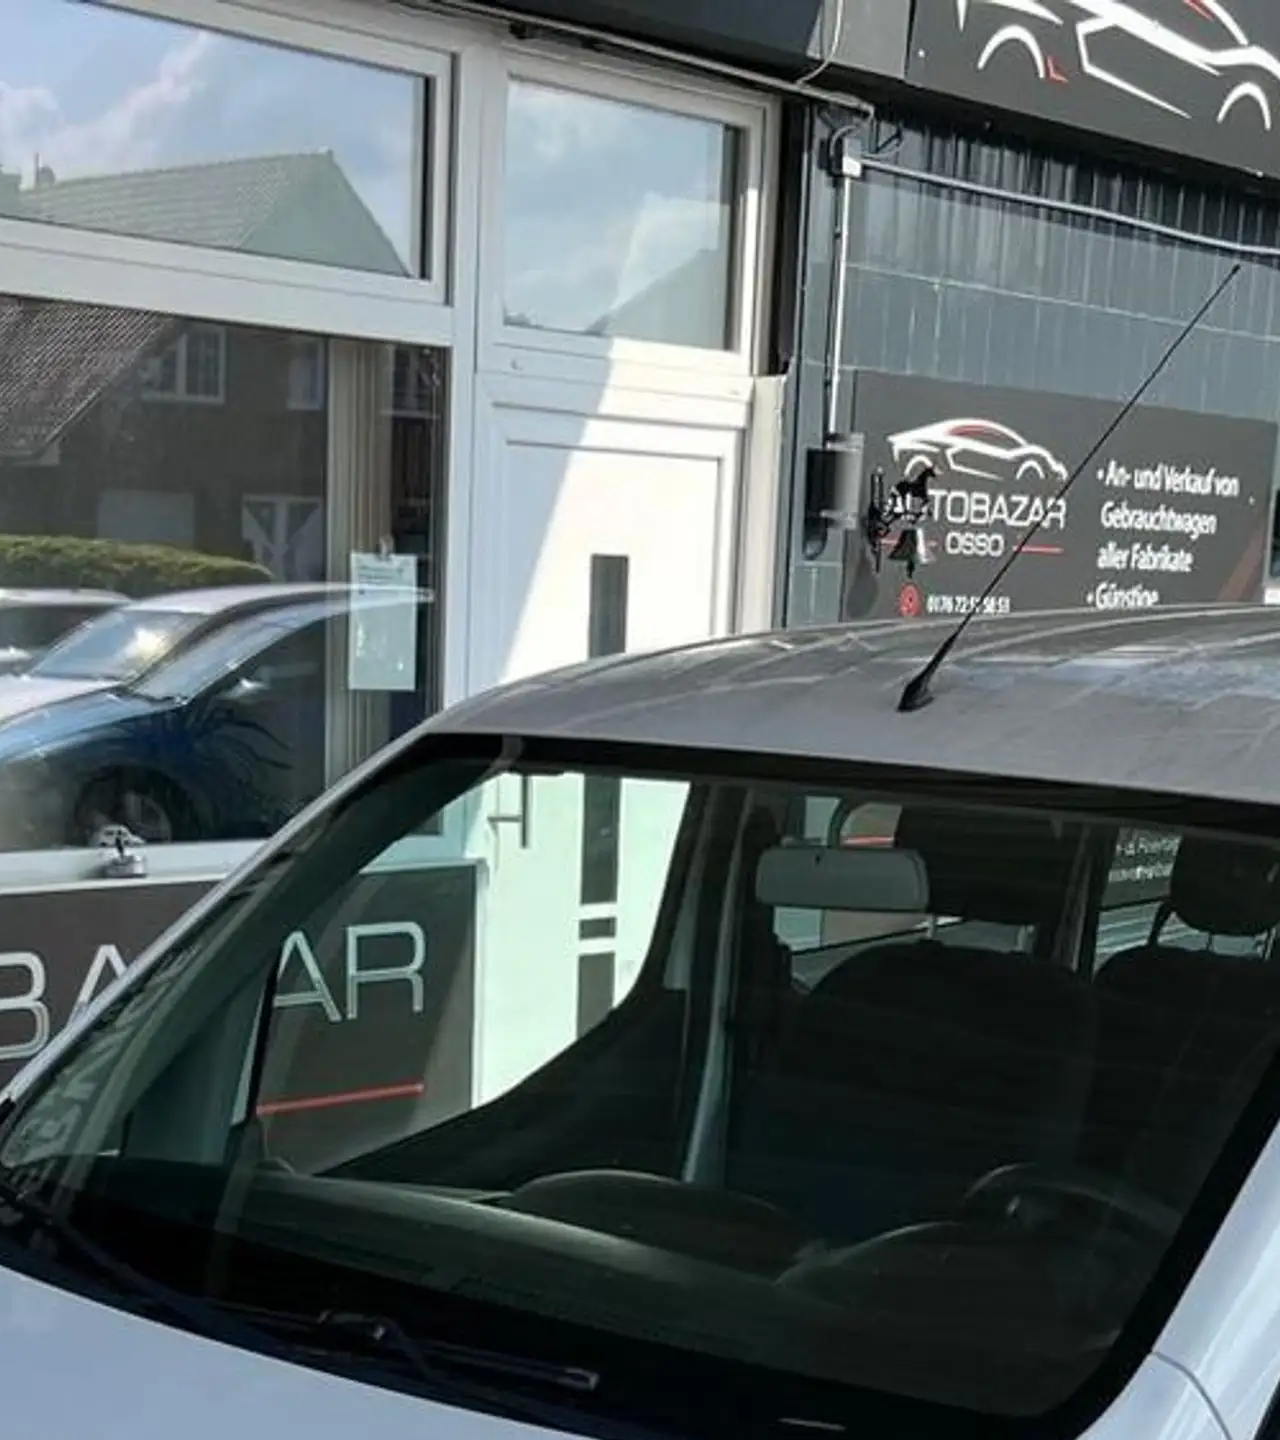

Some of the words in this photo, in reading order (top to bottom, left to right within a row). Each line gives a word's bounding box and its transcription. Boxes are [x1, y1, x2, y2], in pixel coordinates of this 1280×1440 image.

[1134, 463, 1161, 490] und
[1165, 464, 1215, 494] Verkauf
[1215, 476, 1239, 496] von
[1101, 501, 1217, 540] Gebrauchtwagen
[945, 532, 1004, 558] OSSO
[1097, 541, 1129, 569] aller
[1131, 542, 1194, 572] Fabrikate
